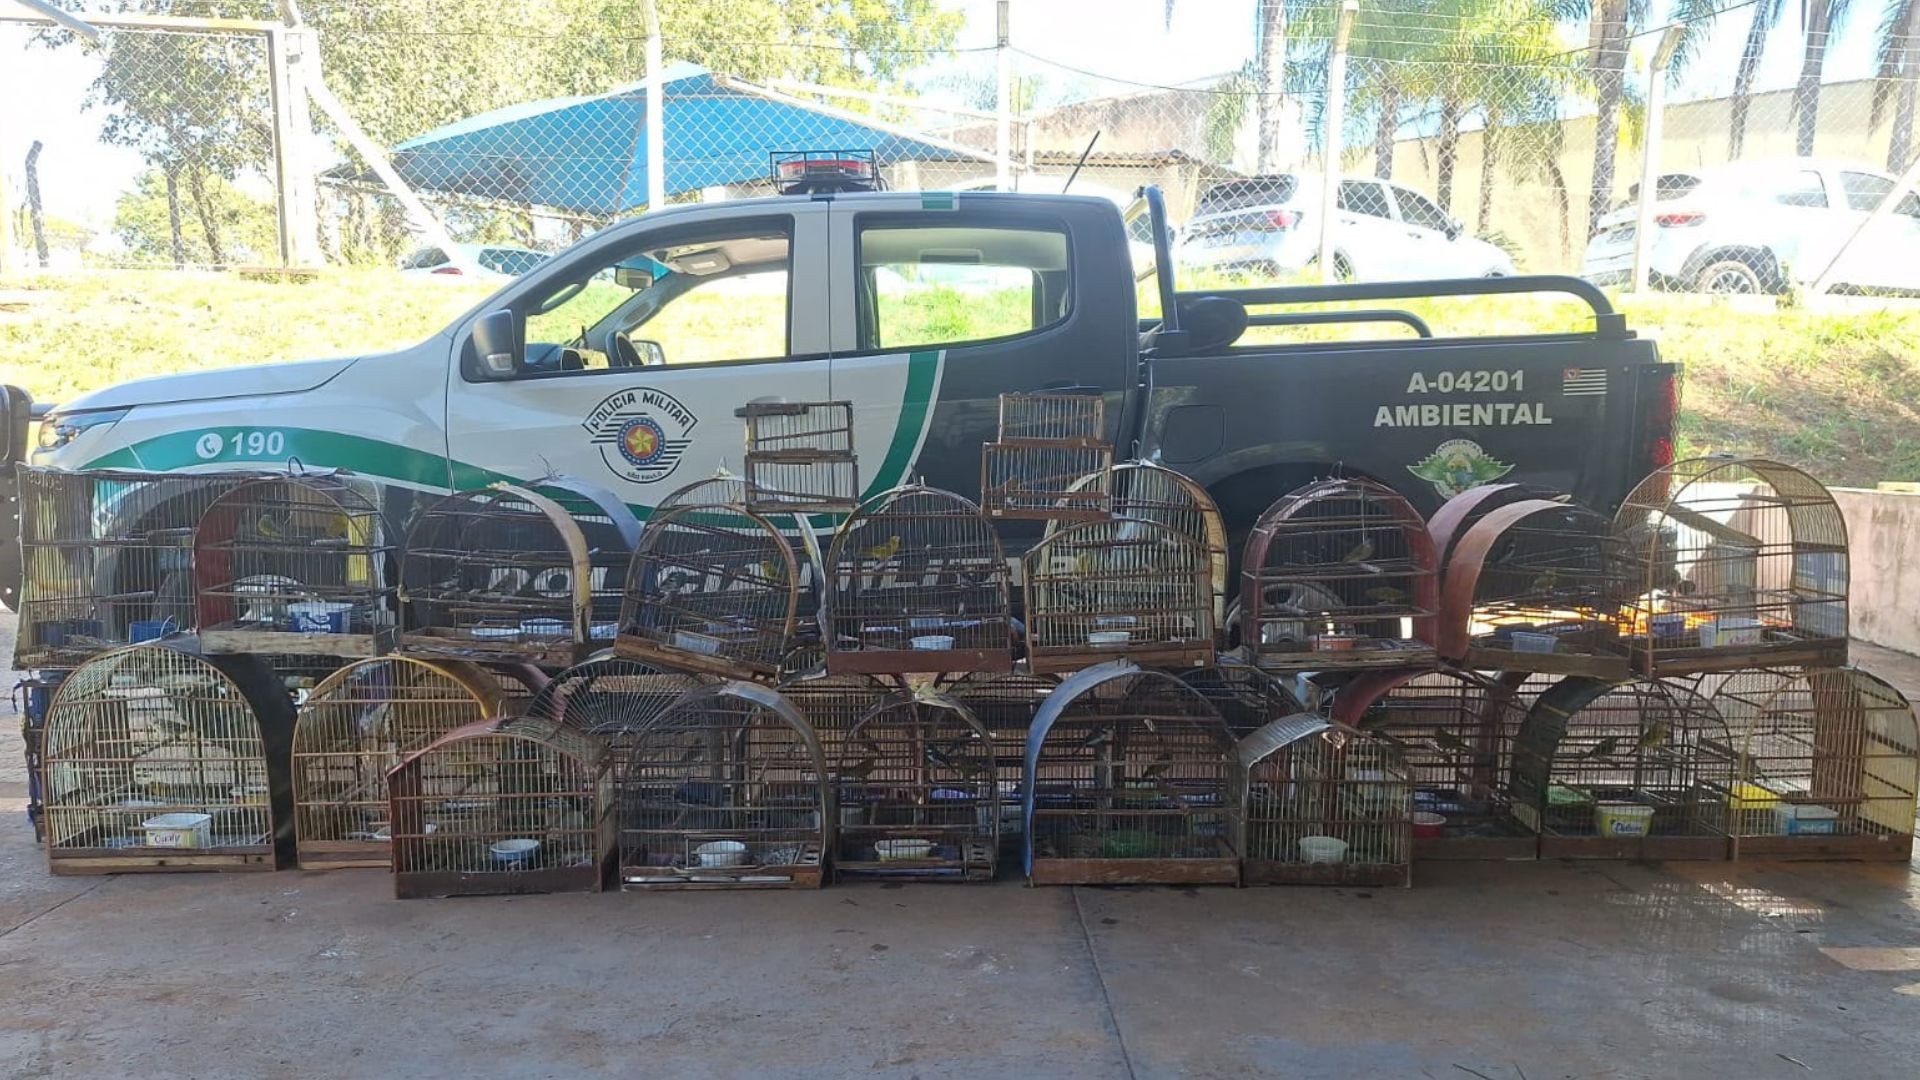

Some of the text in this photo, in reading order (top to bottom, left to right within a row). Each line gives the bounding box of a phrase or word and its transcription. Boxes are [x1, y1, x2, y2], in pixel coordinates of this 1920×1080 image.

[1407, 369, 1524, 394] A-04201
[642, 391, 690, 427] MILITAR
[1374, 402, 1553, 428] AMBIENTAL
[231, 430, 285, 456] 190
